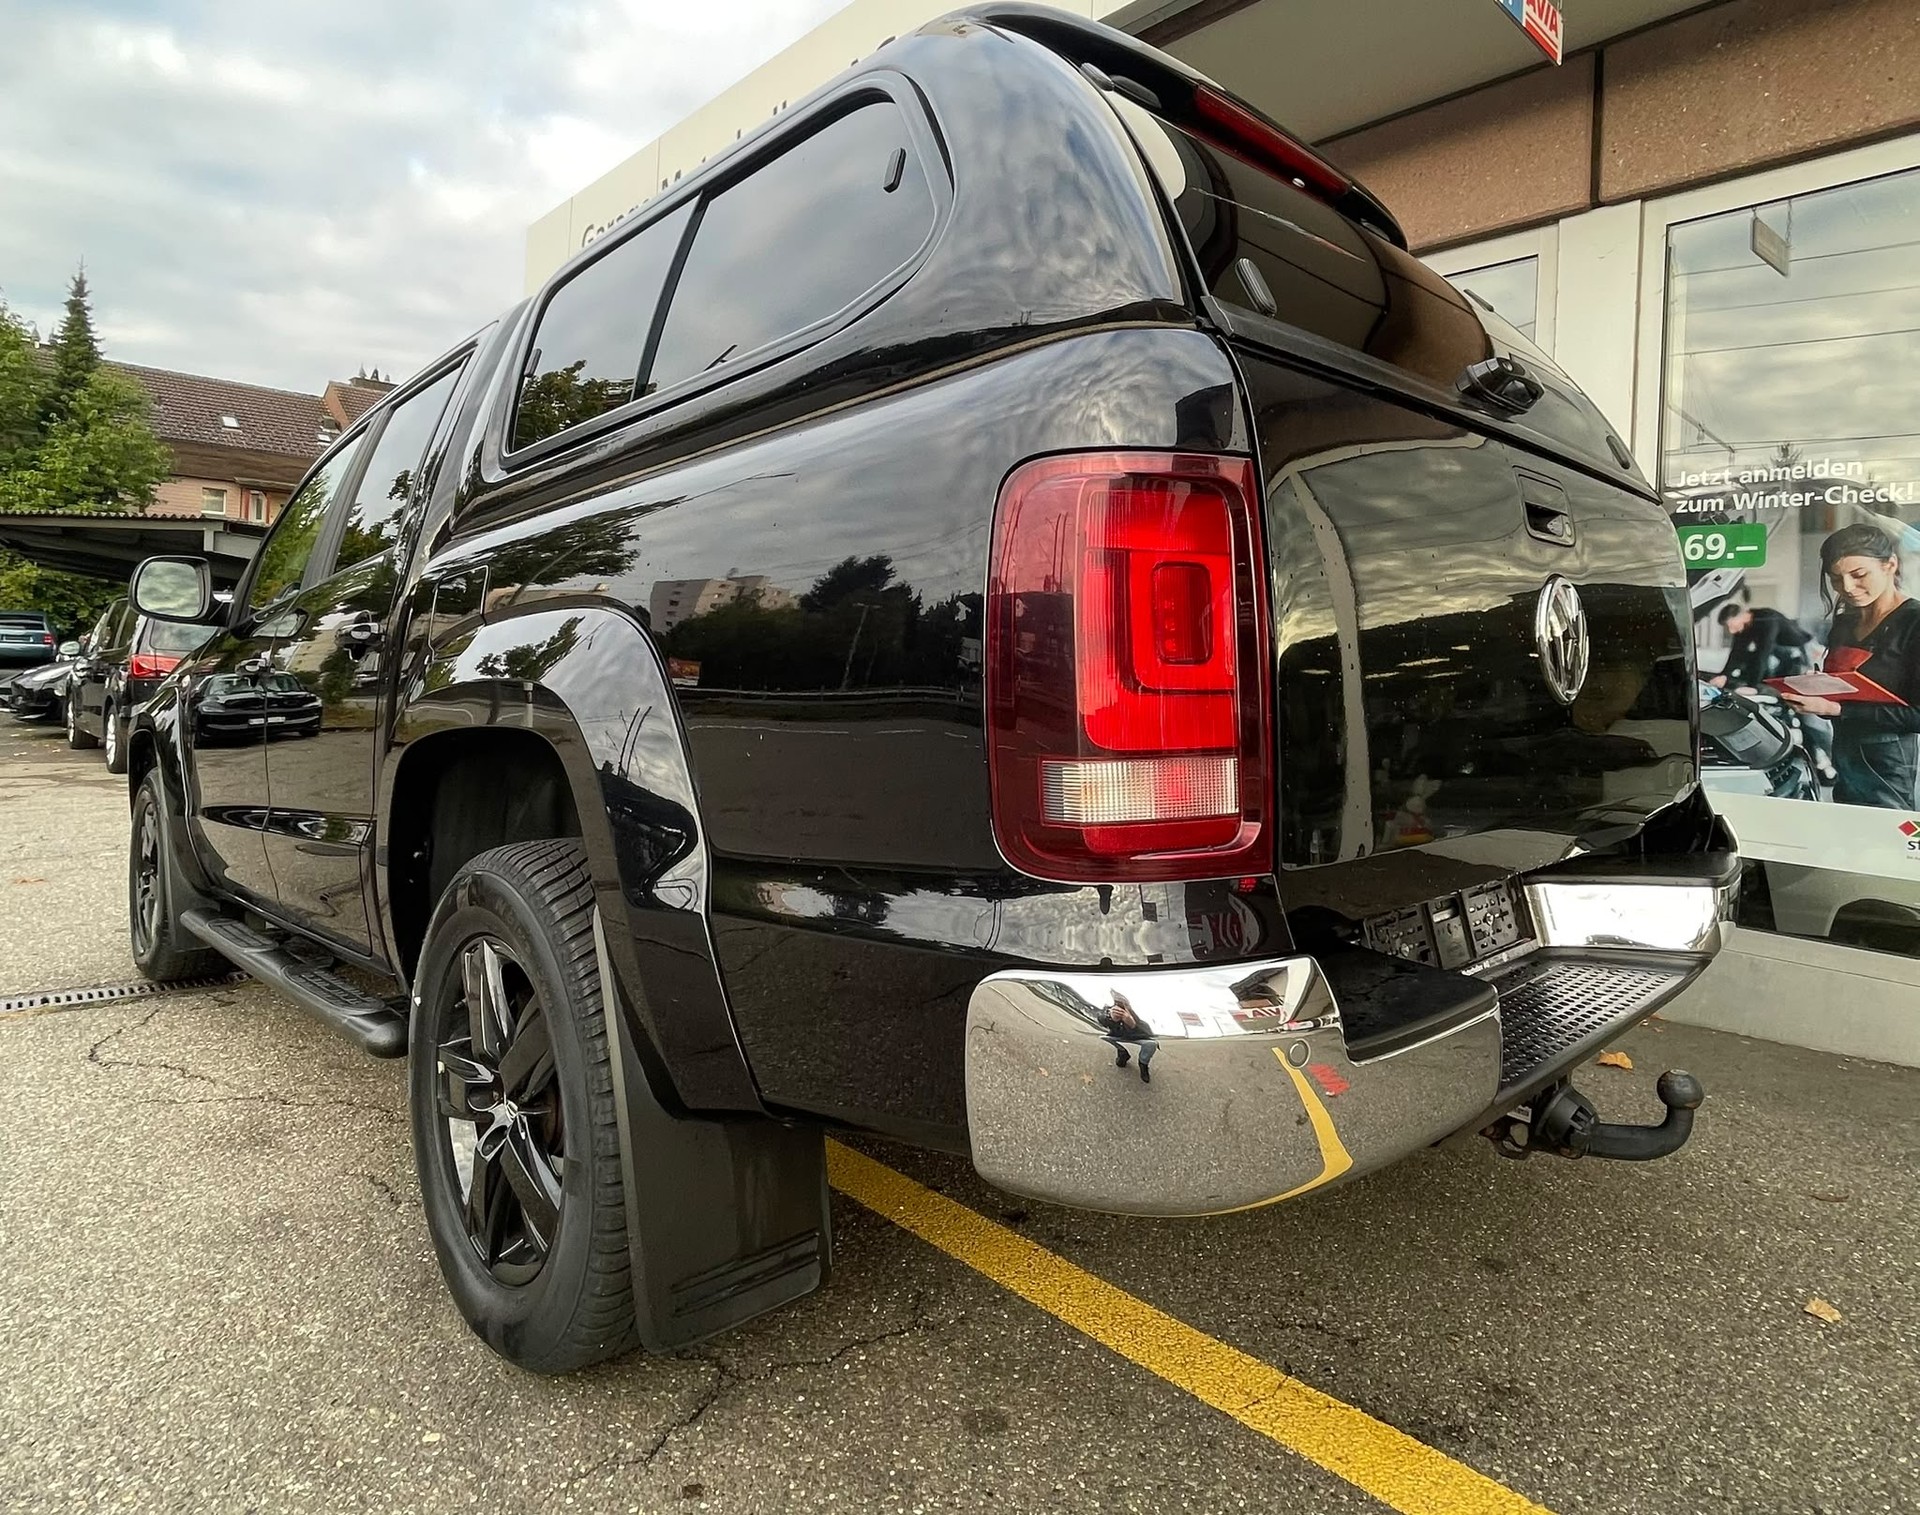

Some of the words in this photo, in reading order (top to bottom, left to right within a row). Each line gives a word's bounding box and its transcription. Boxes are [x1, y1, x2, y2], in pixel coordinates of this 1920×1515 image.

[1677, 470, 1732, 488] Jetzt
[1739, 458, 1863, 484] anmelden
[1676, 497, 1724, 514] zum
[1732, 482, 1914, 511] Winter-Check!
